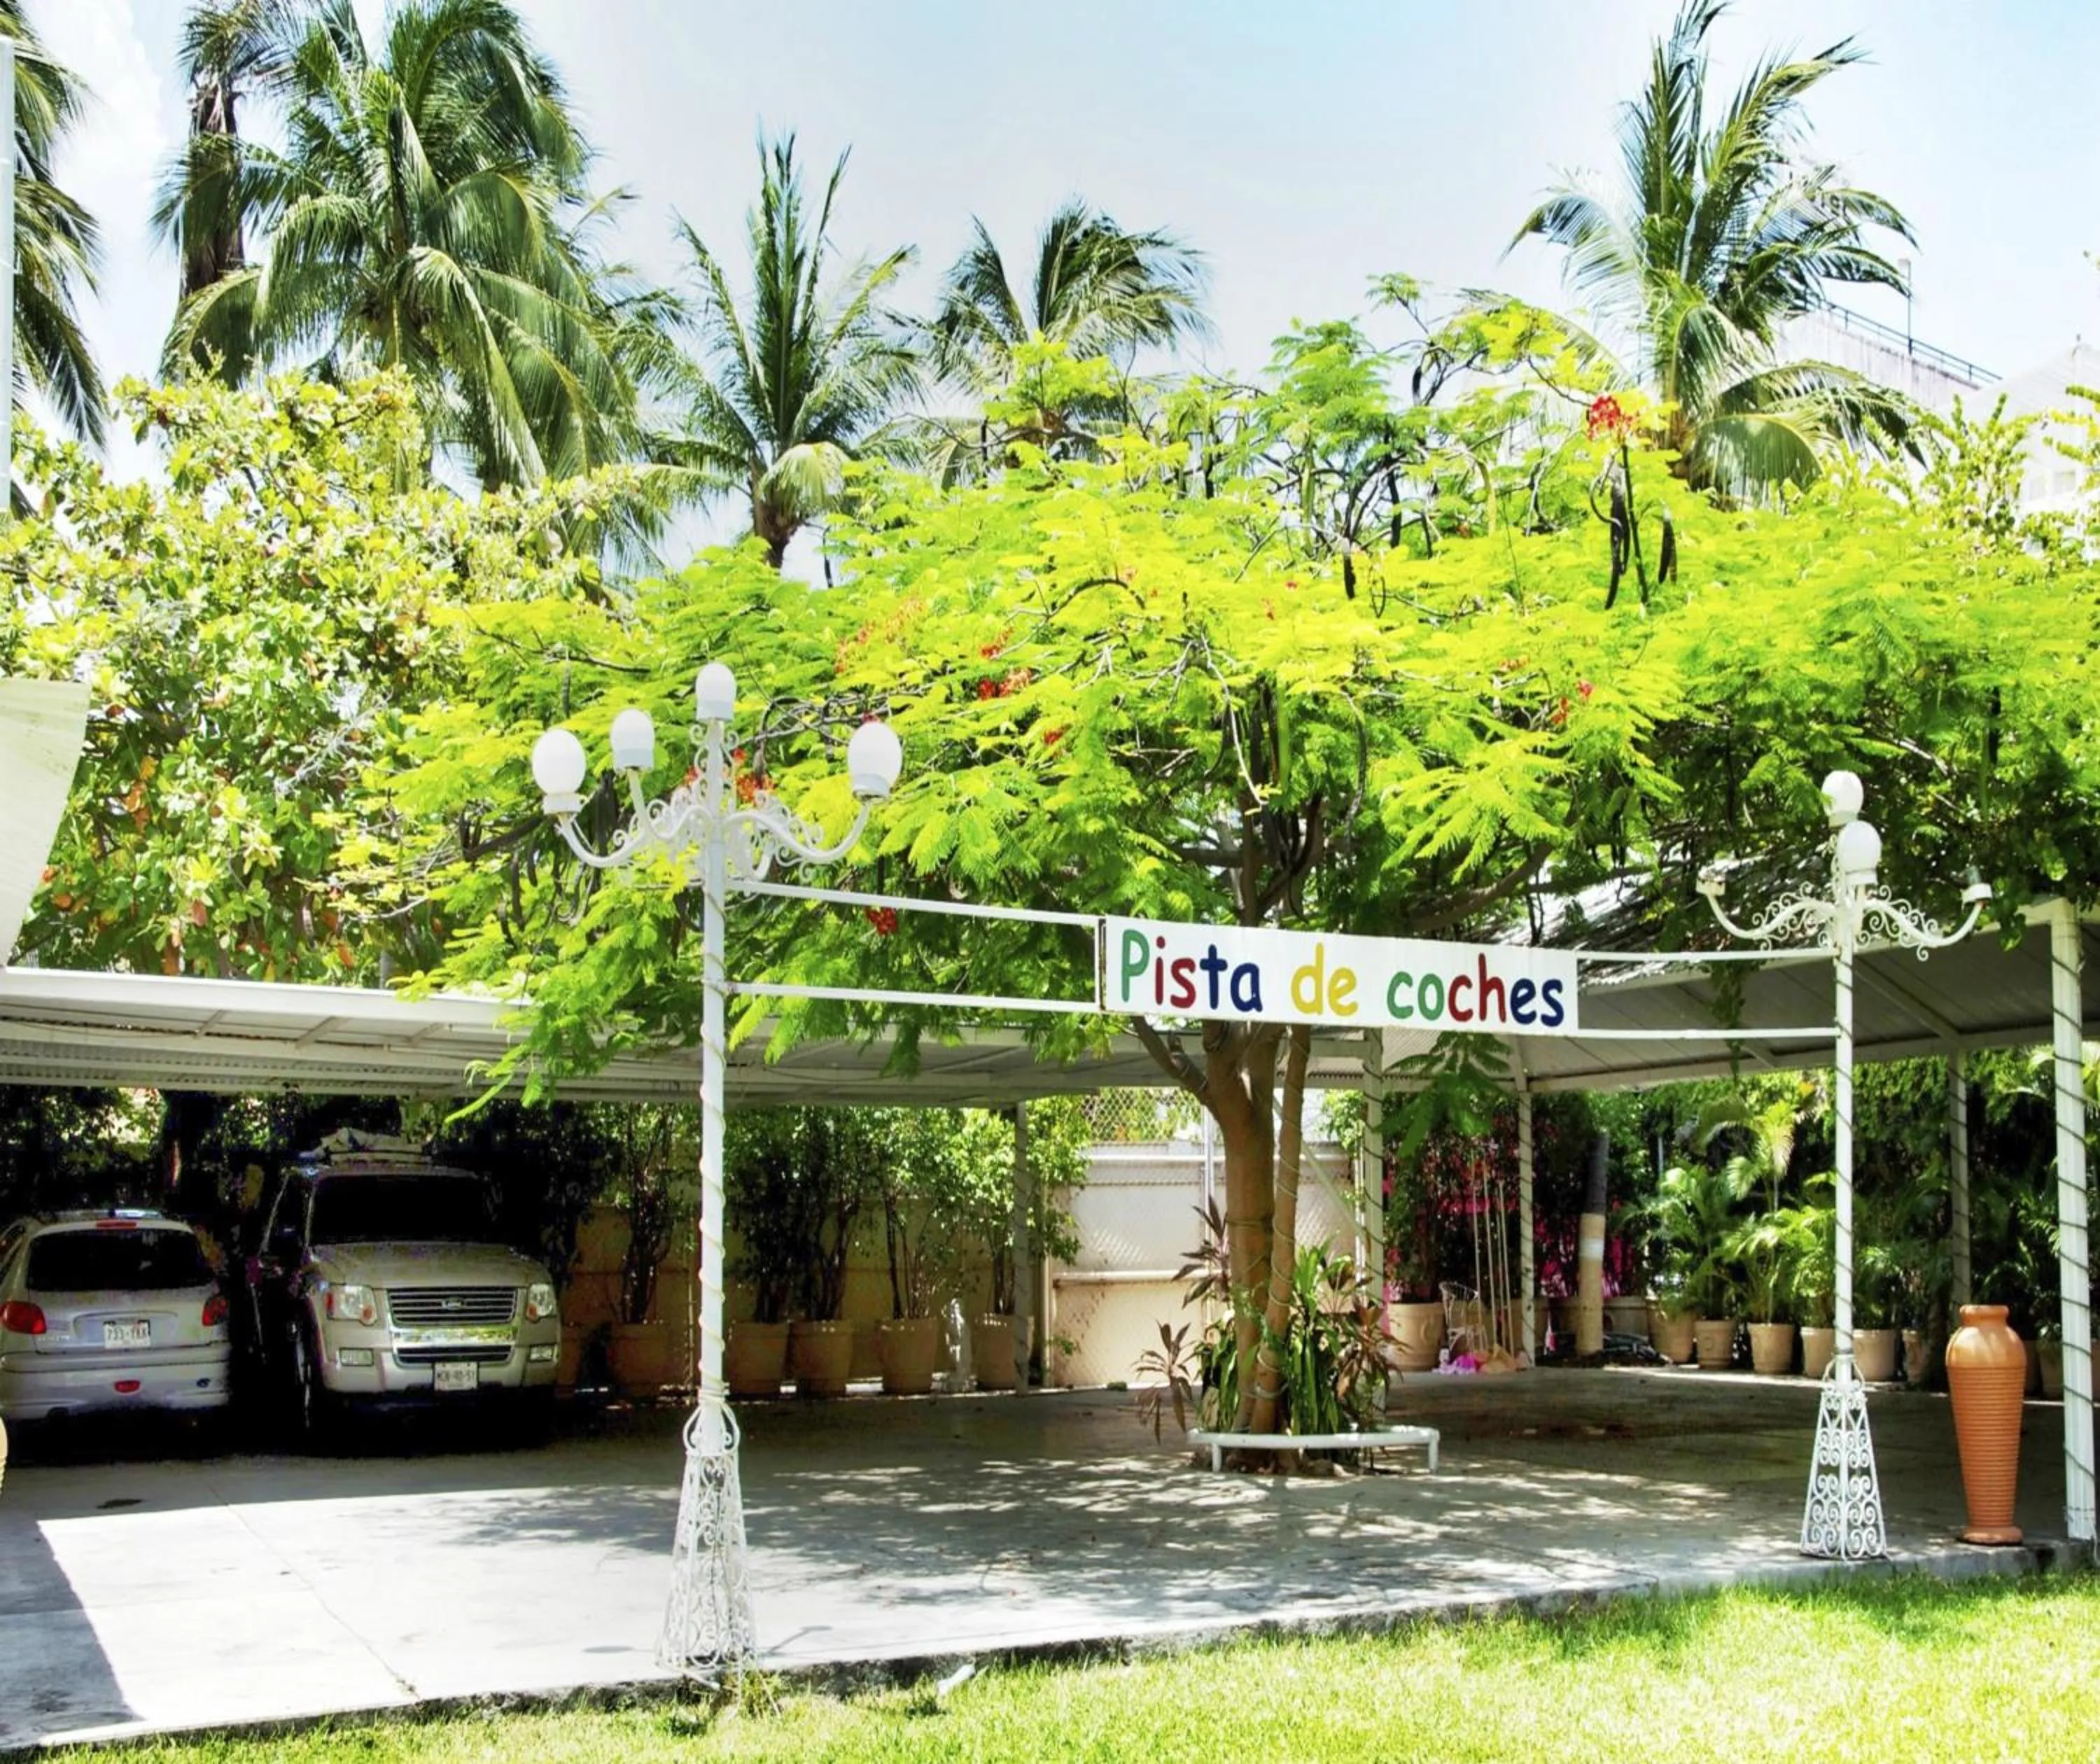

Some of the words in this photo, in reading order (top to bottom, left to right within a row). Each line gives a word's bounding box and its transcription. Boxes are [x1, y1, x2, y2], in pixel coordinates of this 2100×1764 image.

[1121, 930, 1263, 1012] Pista
[1290, 942, 1359, 1017] de
[1387, 953, 1564, 1027] coches
